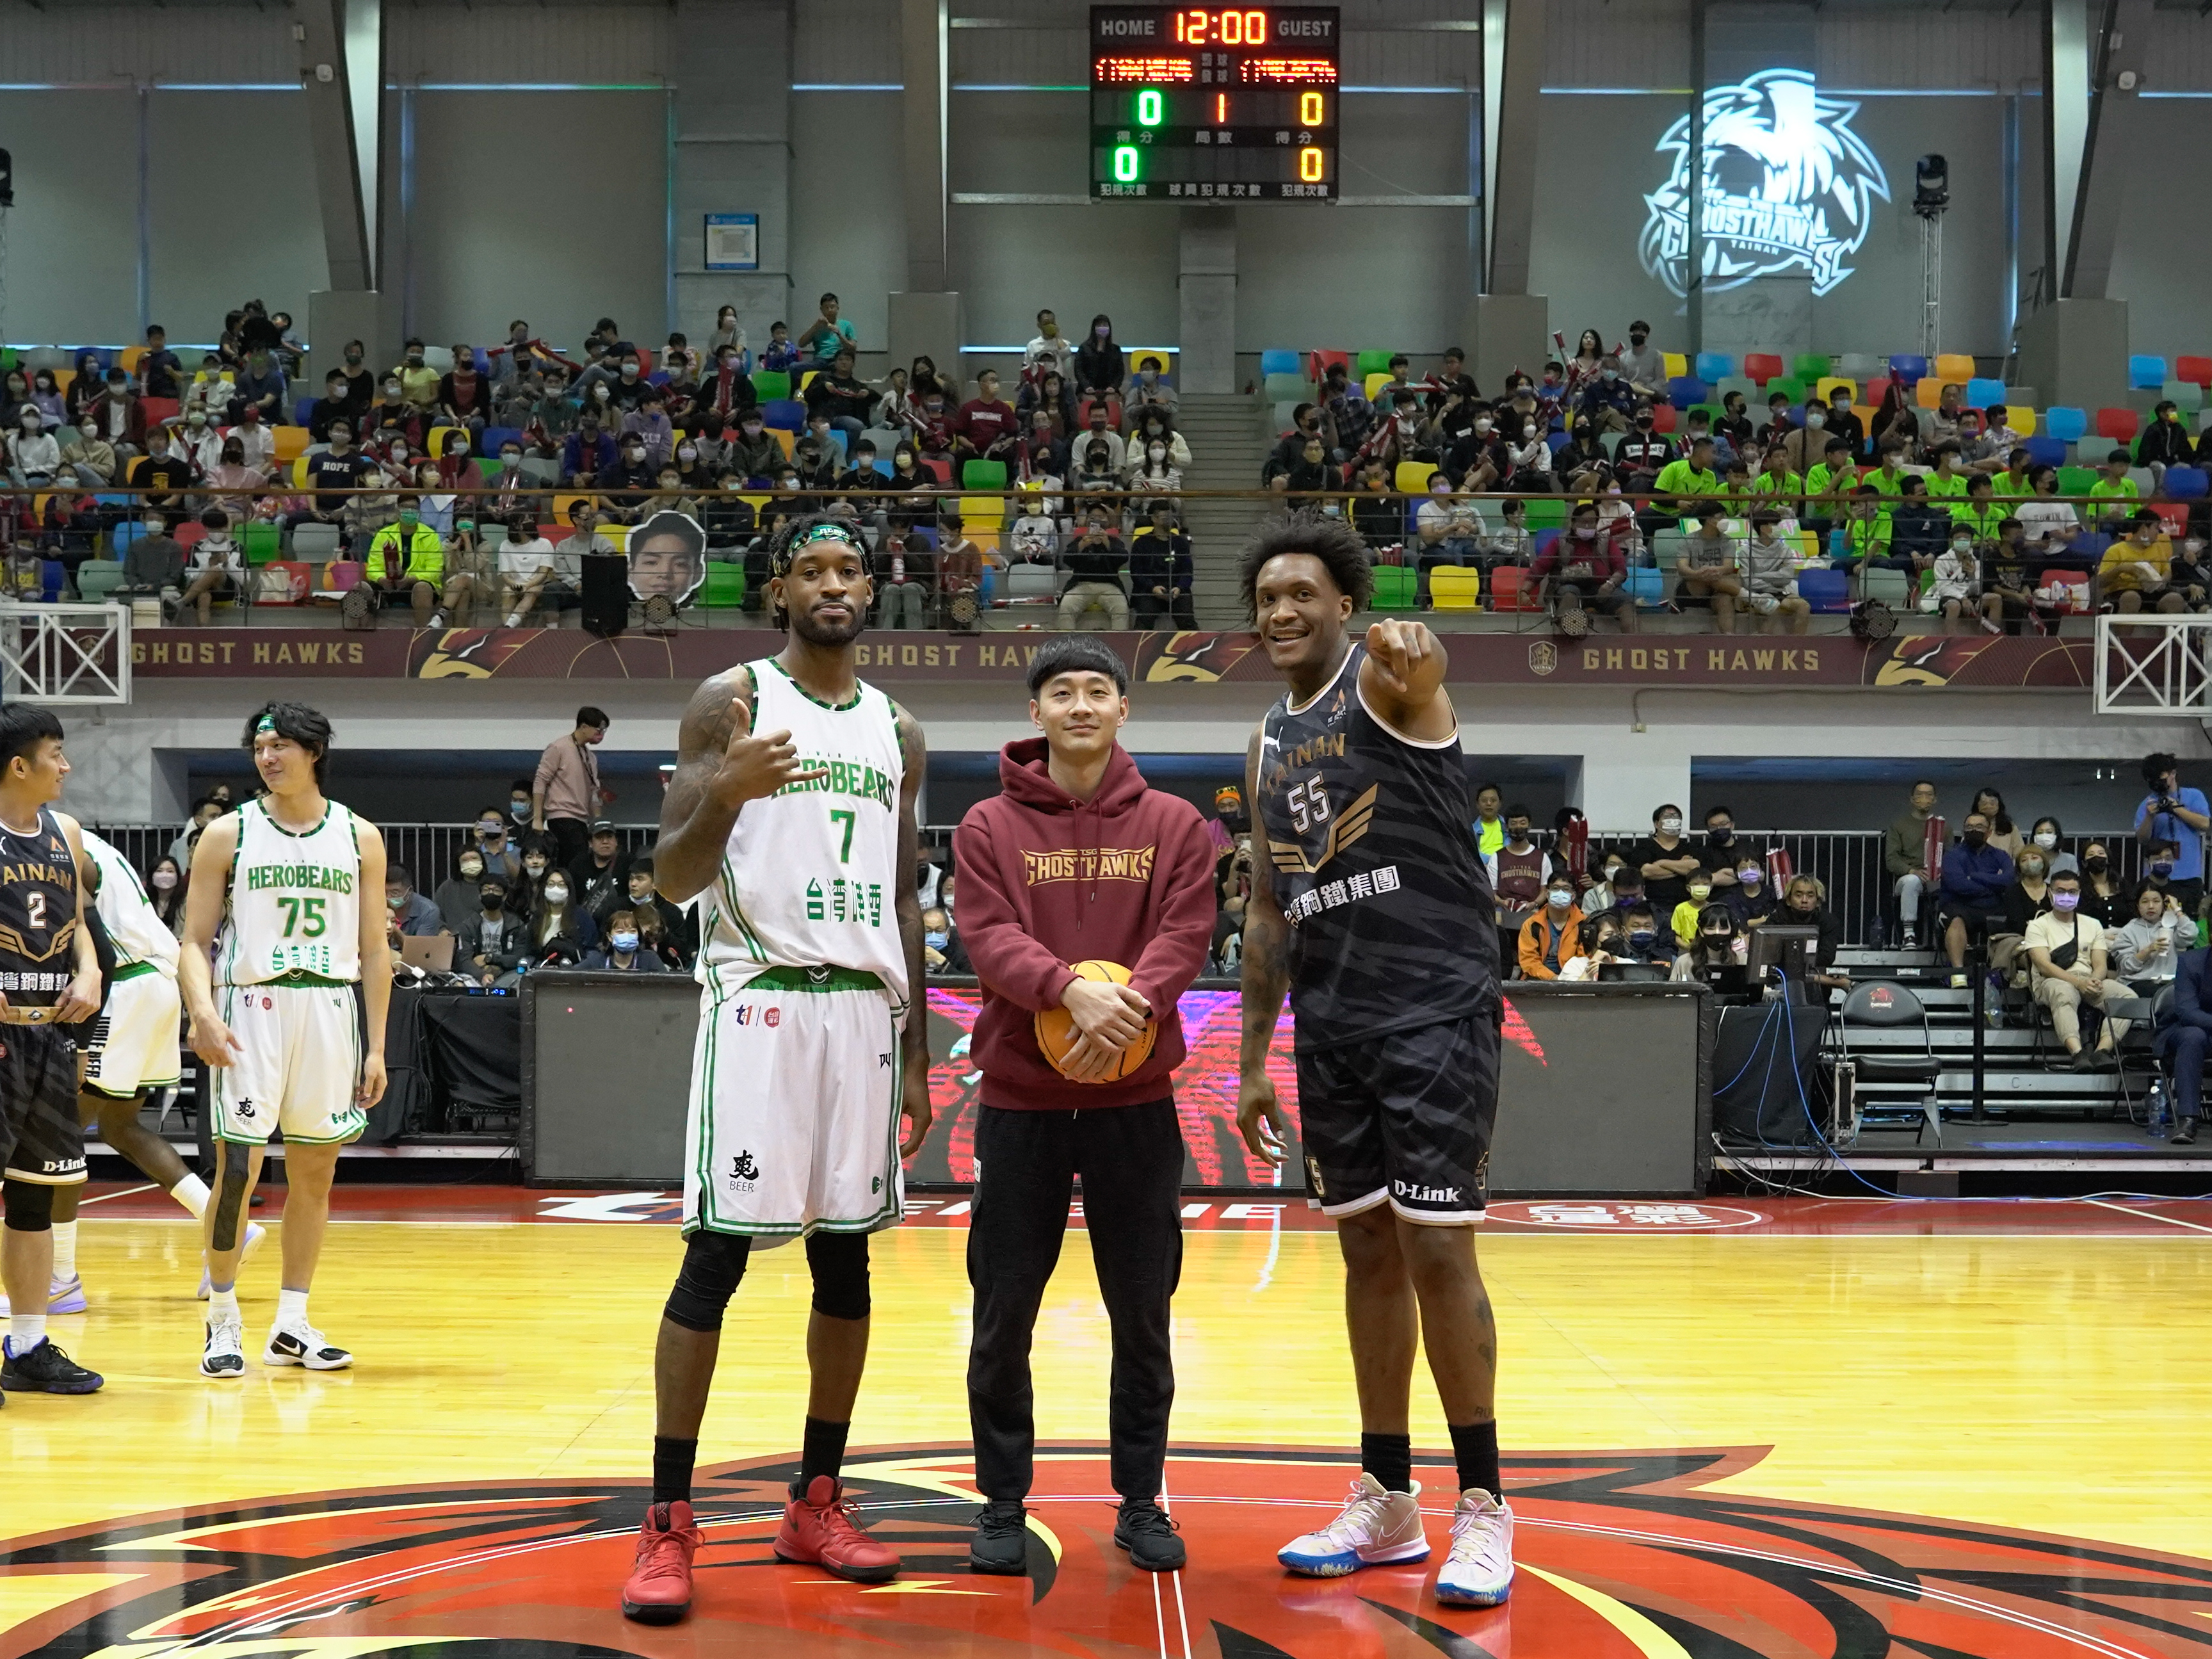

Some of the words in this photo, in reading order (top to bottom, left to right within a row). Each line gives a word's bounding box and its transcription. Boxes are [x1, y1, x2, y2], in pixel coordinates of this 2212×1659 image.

[1101, 20, 1155, 36] HOME
[1177, 11, 1266, 44] 12:00
[1279, 20, 1332, 36] GUEST
[1138, 91, 1161, 125] 0
[1218, 93, 1225, 123] 1
[1301, 92, 1323, 126] 0
[1115, 147, 1138, 181] 0
[1301, 148, 1322, 181] 0
[322, 461, 350, 472] HOPE
[132, 643, 236, 664] GHOST
[253, 643, 364, 664] HAWKS
[855, 645, 962, 666] GHOST
[1583, 649, 1691, 670] GHOST
[1708, 649, 1820, 671] HAWKS
[1287, 771, 1334, 836] 55
[830, 809, 855, 864] 7
[248, 864, 353, 895] HEROBEARS
[1024, 845, 1156, 886] GHOSTHAWKS
[27, 891, 47, 928] 2
[277, 896, 327, 937] 75
[43, 1158, 86, 1173] D-Link
[729, 1180, 754, 1192] BEER
[1394, 1179, 1460, 1202] D-Link
